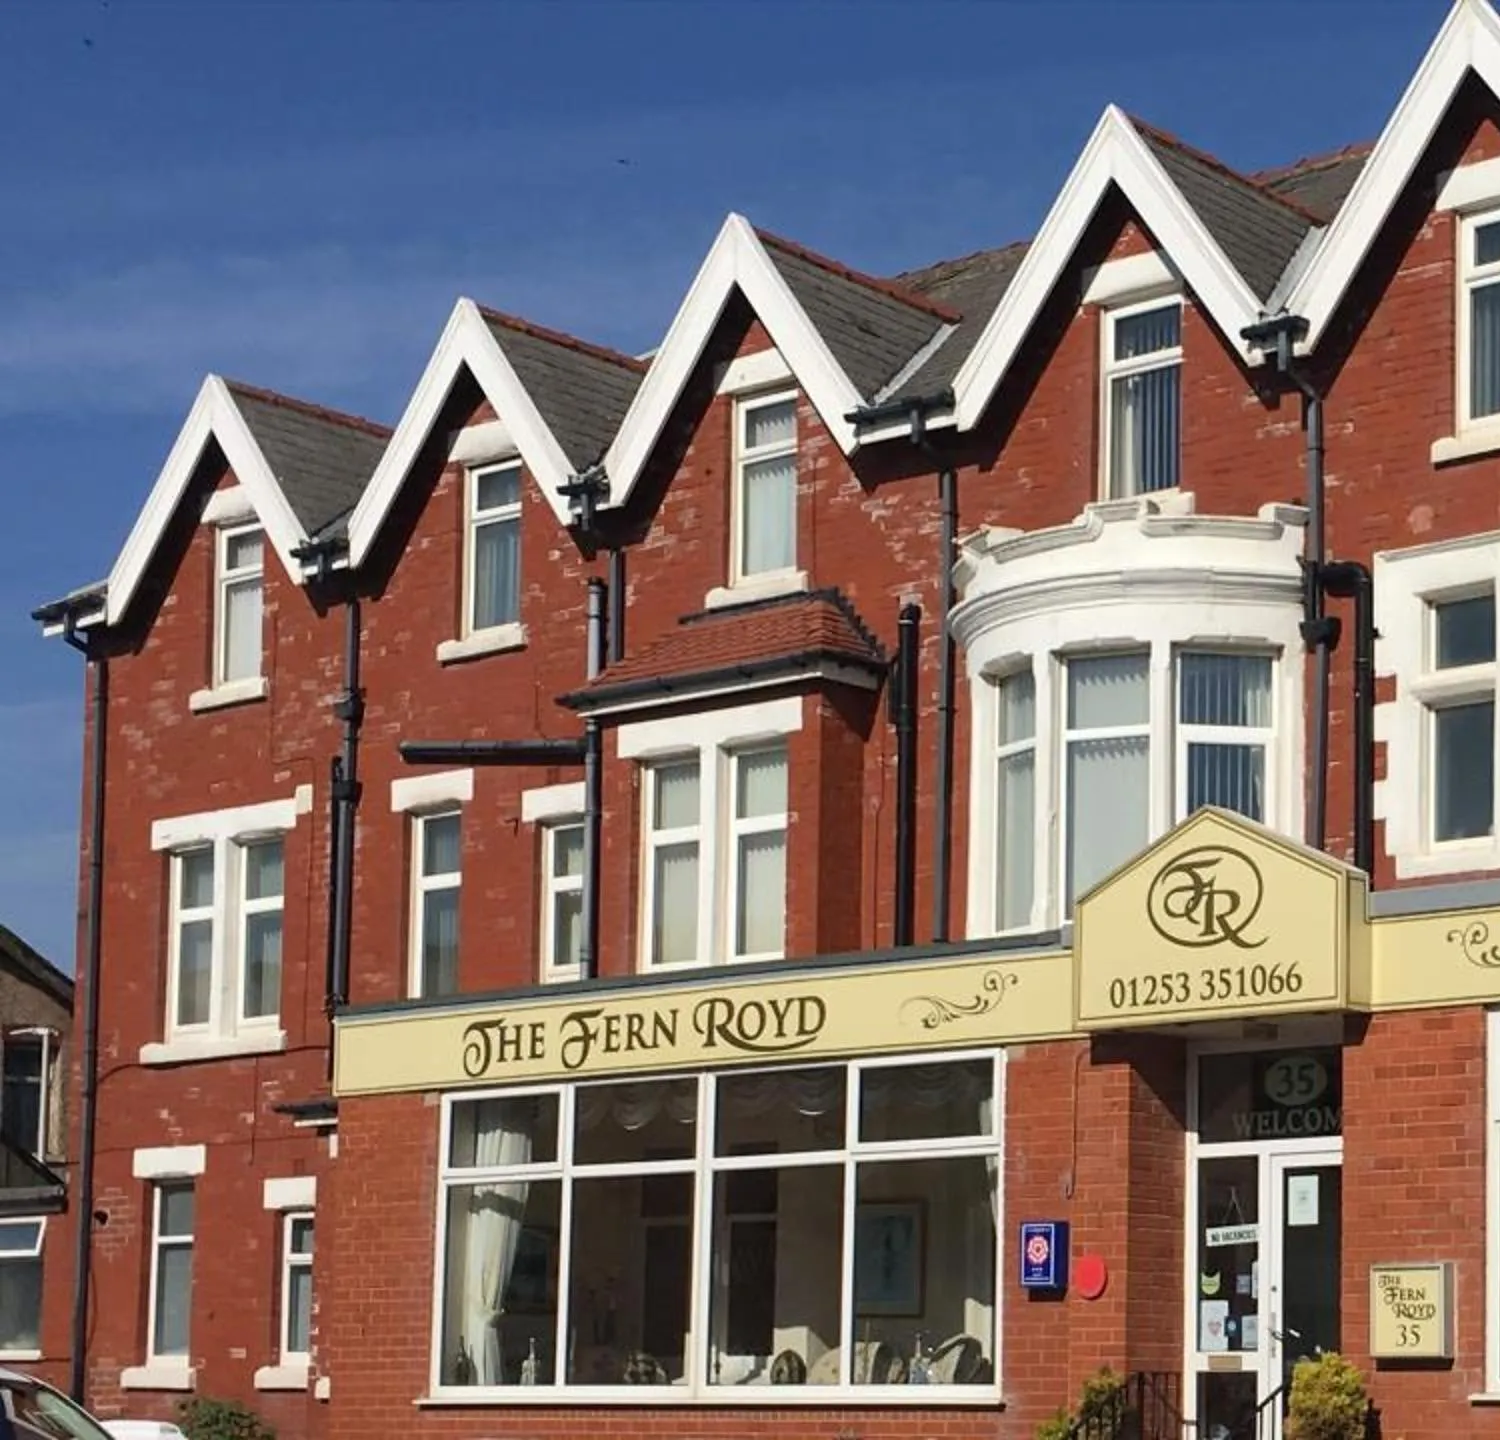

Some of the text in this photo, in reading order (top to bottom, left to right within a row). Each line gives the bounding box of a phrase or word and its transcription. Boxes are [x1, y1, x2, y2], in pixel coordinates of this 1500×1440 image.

[1110, 961, 1303, 1009] 01253 351066
[462, 995, 827, 1077] THE FERN ROYD
[1275, 1063, 1316, 1097] 35
[1378, 1275, 1401, 1288] THE
[1383, 1286, 1426, 1305] FERN
[1391, 1302, 1436, 1321] ROYD
[1396, 1324, 1421, 1347] 35
